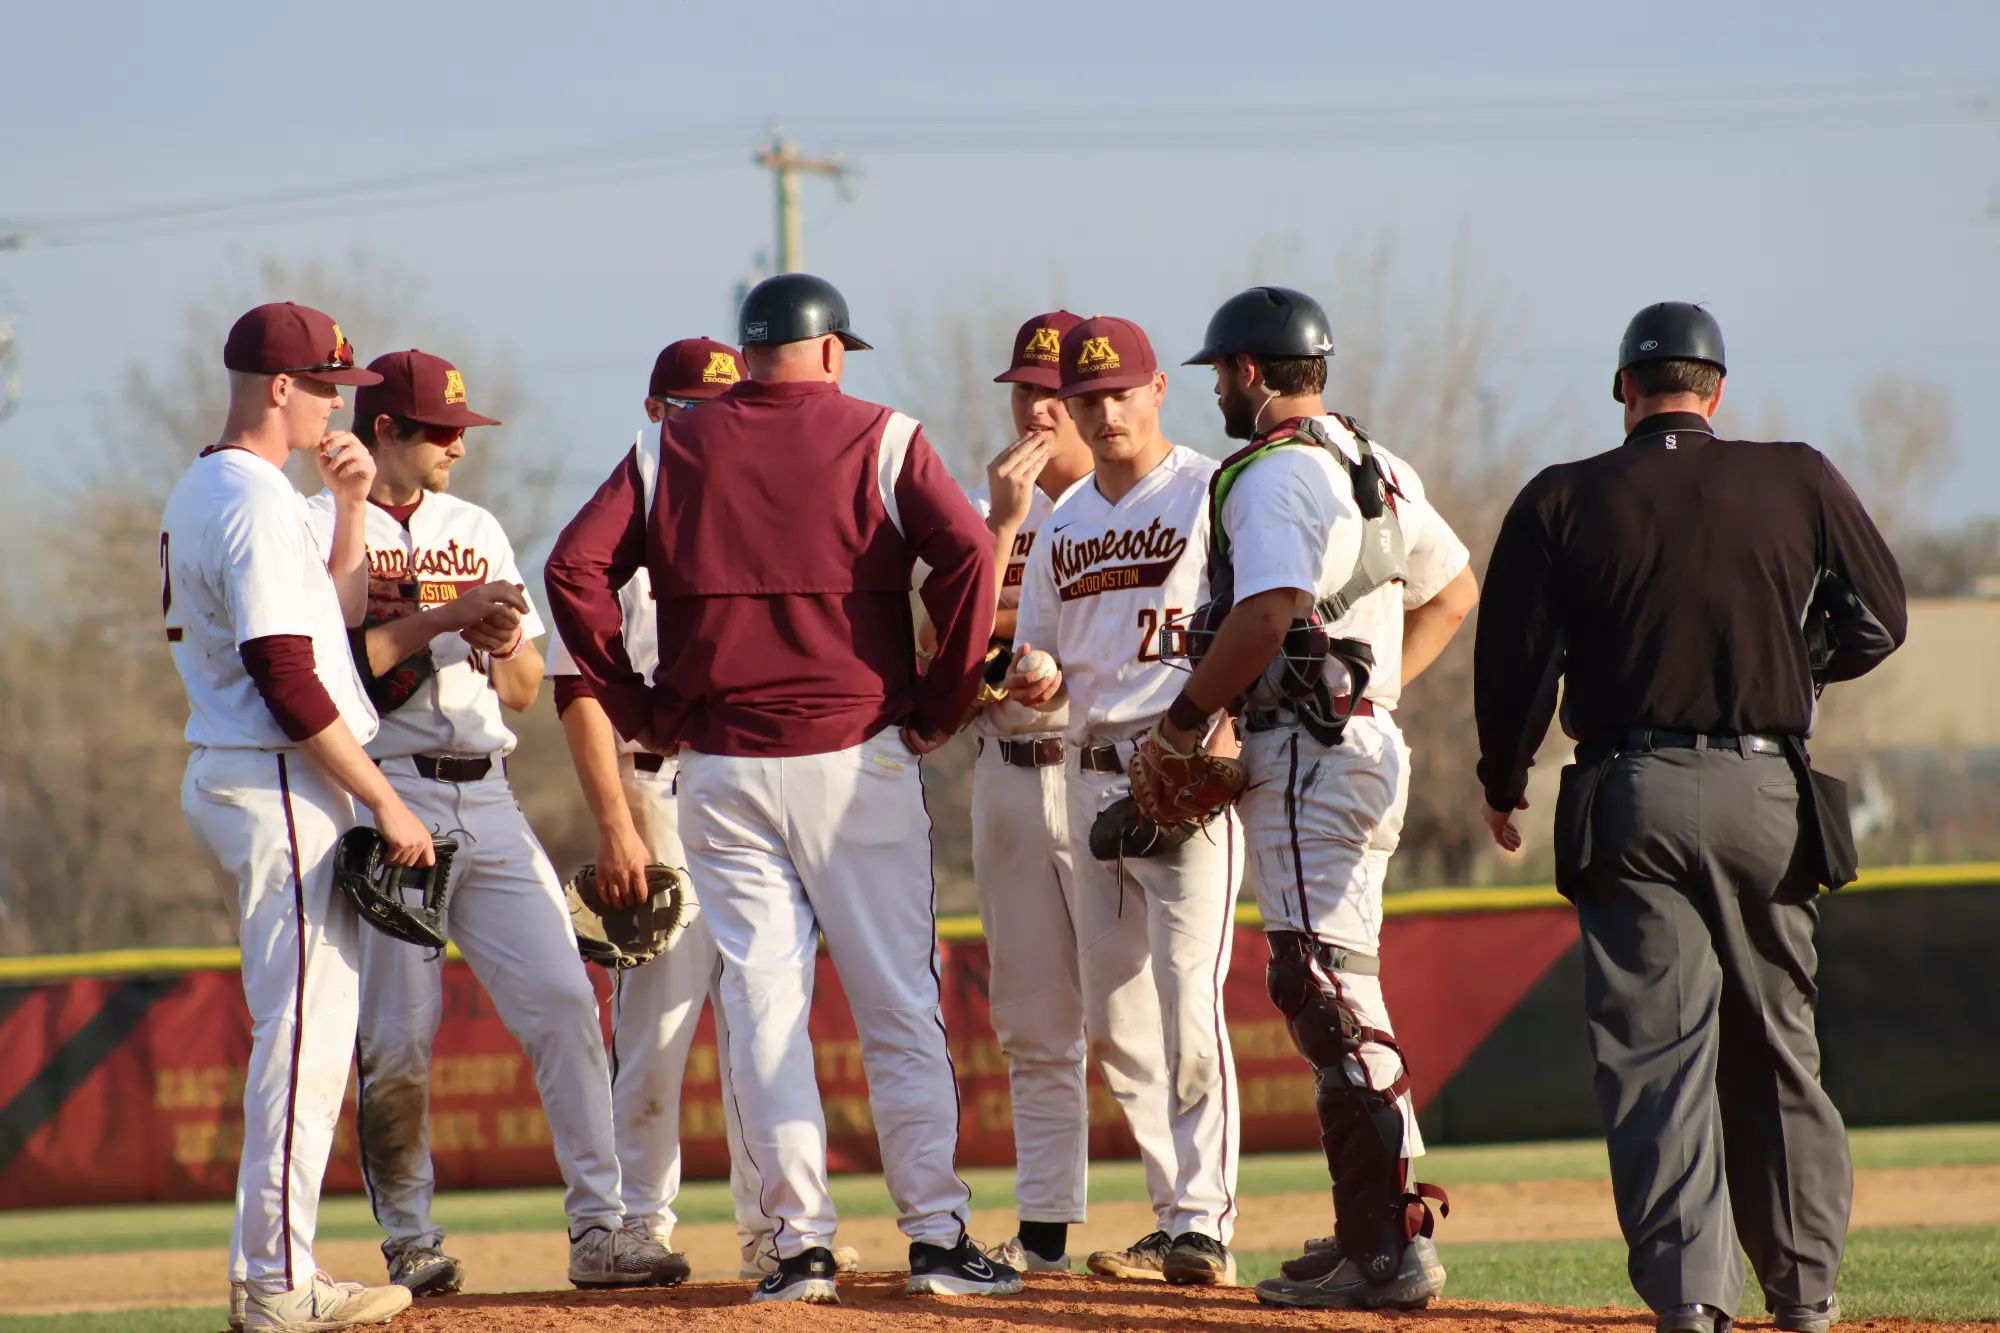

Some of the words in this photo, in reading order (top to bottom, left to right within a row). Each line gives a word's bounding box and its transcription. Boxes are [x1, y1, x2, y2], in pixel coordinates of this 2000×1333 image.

[1077, 336, 1120, 365] M
[703, 352, 740, 382] M
[1077, 362, 1120, 374] CROOKSTON
[1051, 516, 1187, 587] Minnesota
[420, 584, 458, 600] KSTON
[1070, 568, 1139, 596] CROOKSTON
